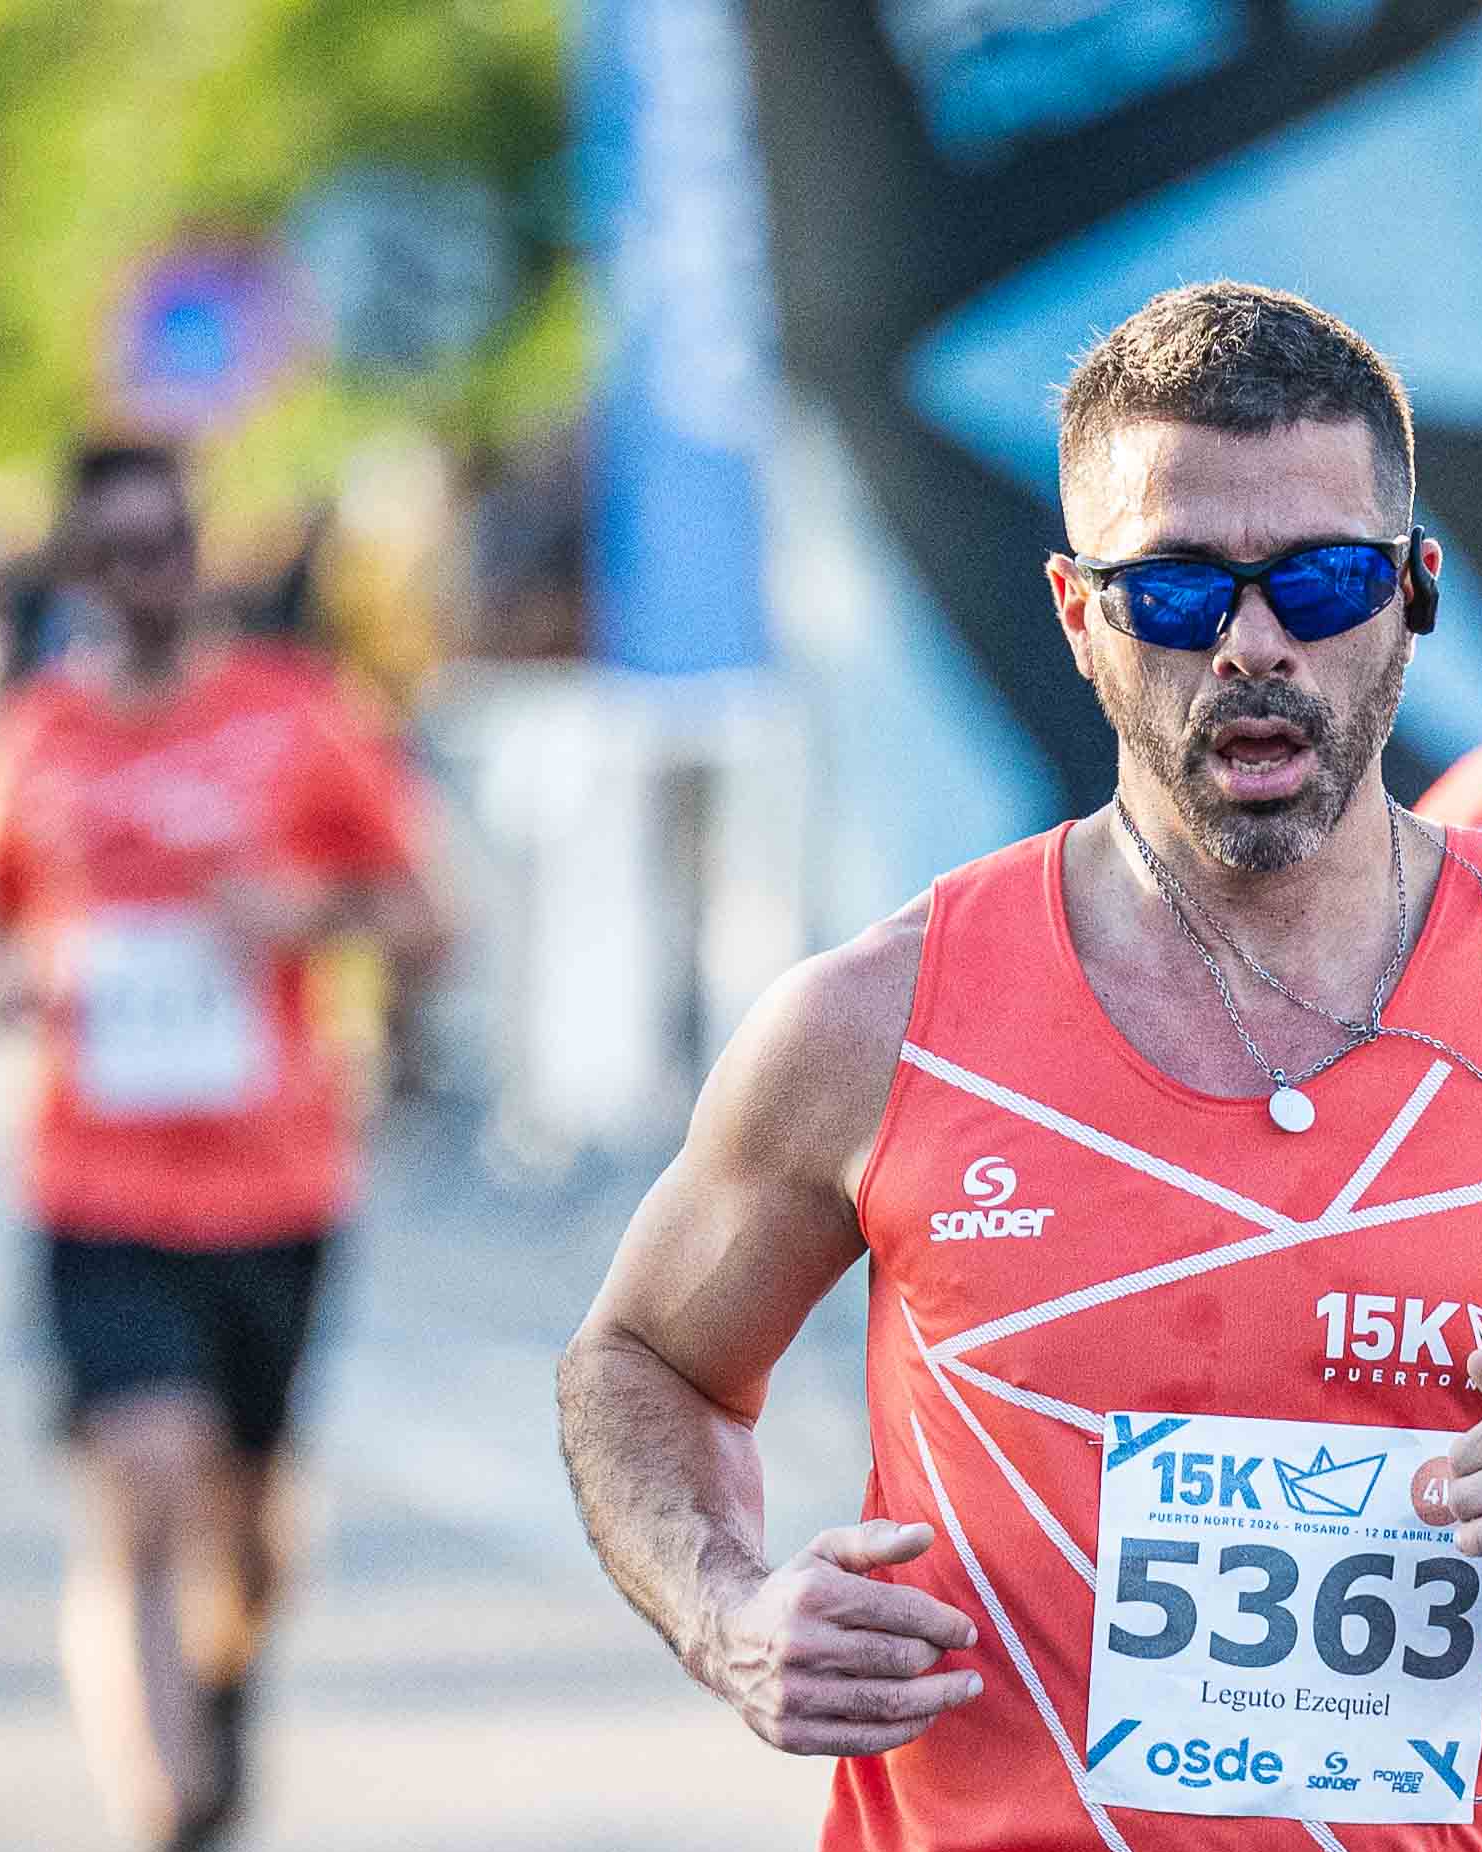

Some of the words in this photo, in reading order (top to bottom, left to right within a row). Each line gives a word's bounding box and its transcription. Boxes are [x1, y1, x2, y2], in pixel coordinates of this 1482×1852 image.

[1315, 1290, 1461, 1367] 15K
[1323, 1366, 1452, 1387] PUERTO
[1151, 1451, 1264, 1511] 15K
[1148, 1511, 1200, 1526] PUERTO
[1203, 1515, 1245, 1529] NORTE
[1249, 1519, 1280, 1531] 2026
[1293, 1522, 1350, 1536] ROSARIO
[1365, 1527, 1380, 1539] 12
[1383, 1528, 1399, 1540] DE
[1402, 1530, 1432, 1542] ABRIL
[1107, 1536, 1481, 1682] 5363
[1199, 1679, 1286, 1712] Leguto
[1293, 1687, 1391, 1720] Ezequiel
[1146, 1737, 1284, 1786] osde
[1373, 1770, 1425, 1783] POWER
